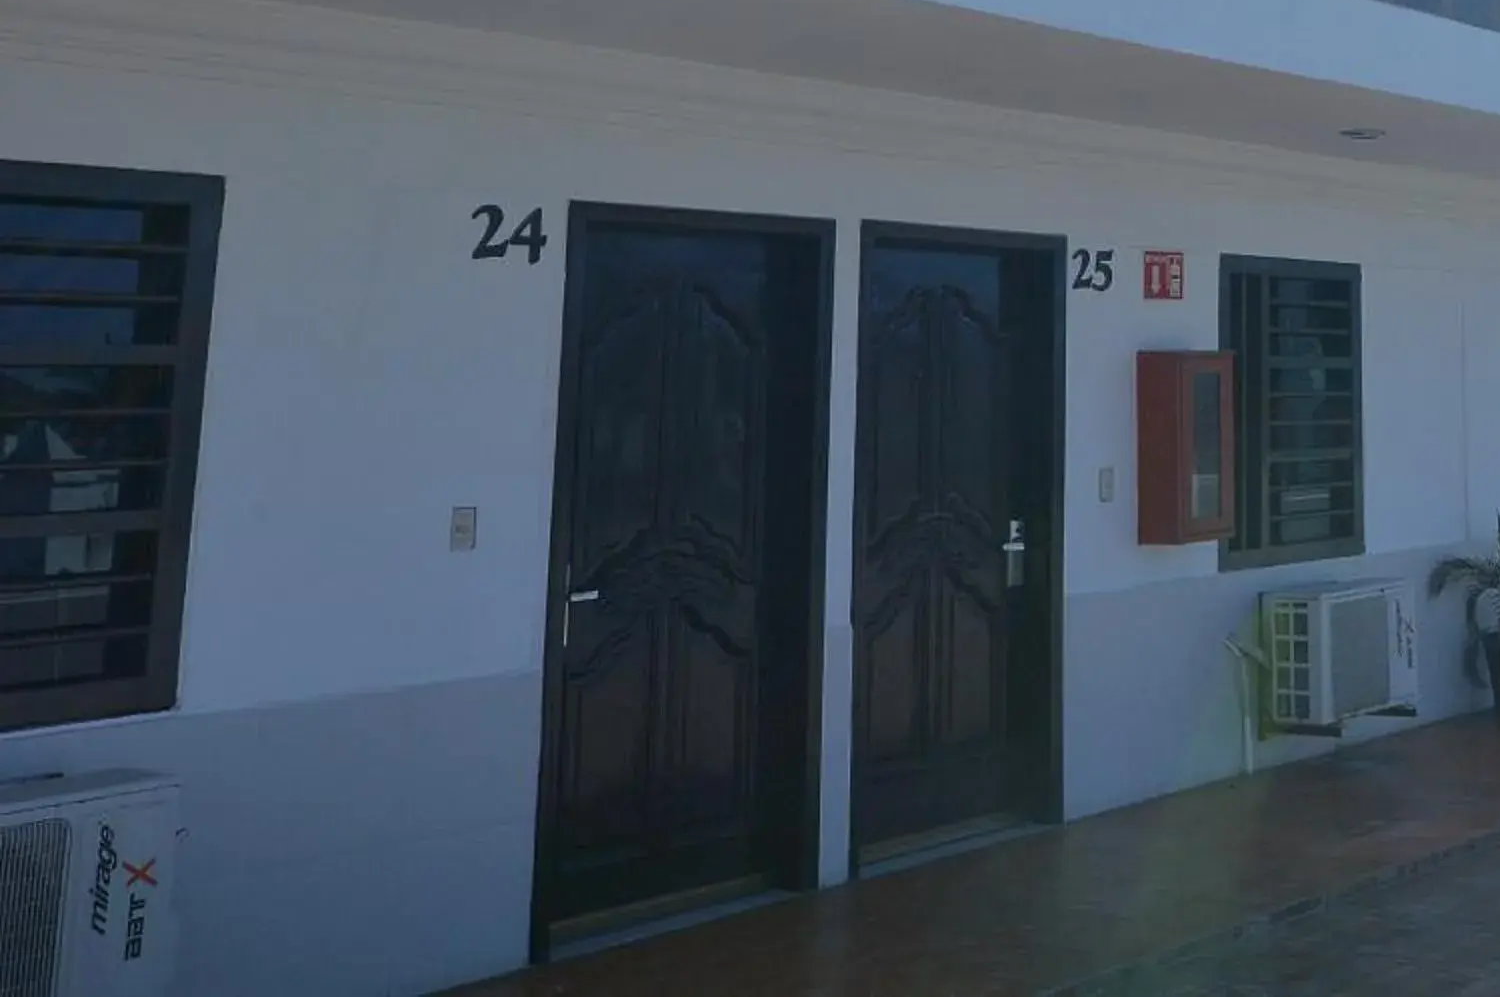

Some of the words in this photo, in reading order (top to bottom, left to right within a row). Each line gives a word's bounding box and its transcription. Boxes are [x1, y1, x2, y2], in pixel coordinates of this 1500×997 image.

[471, 204, 548, 265] 24
[1072, 249, 1115, 291] 25
[89, 823, 117, 935] mirage
